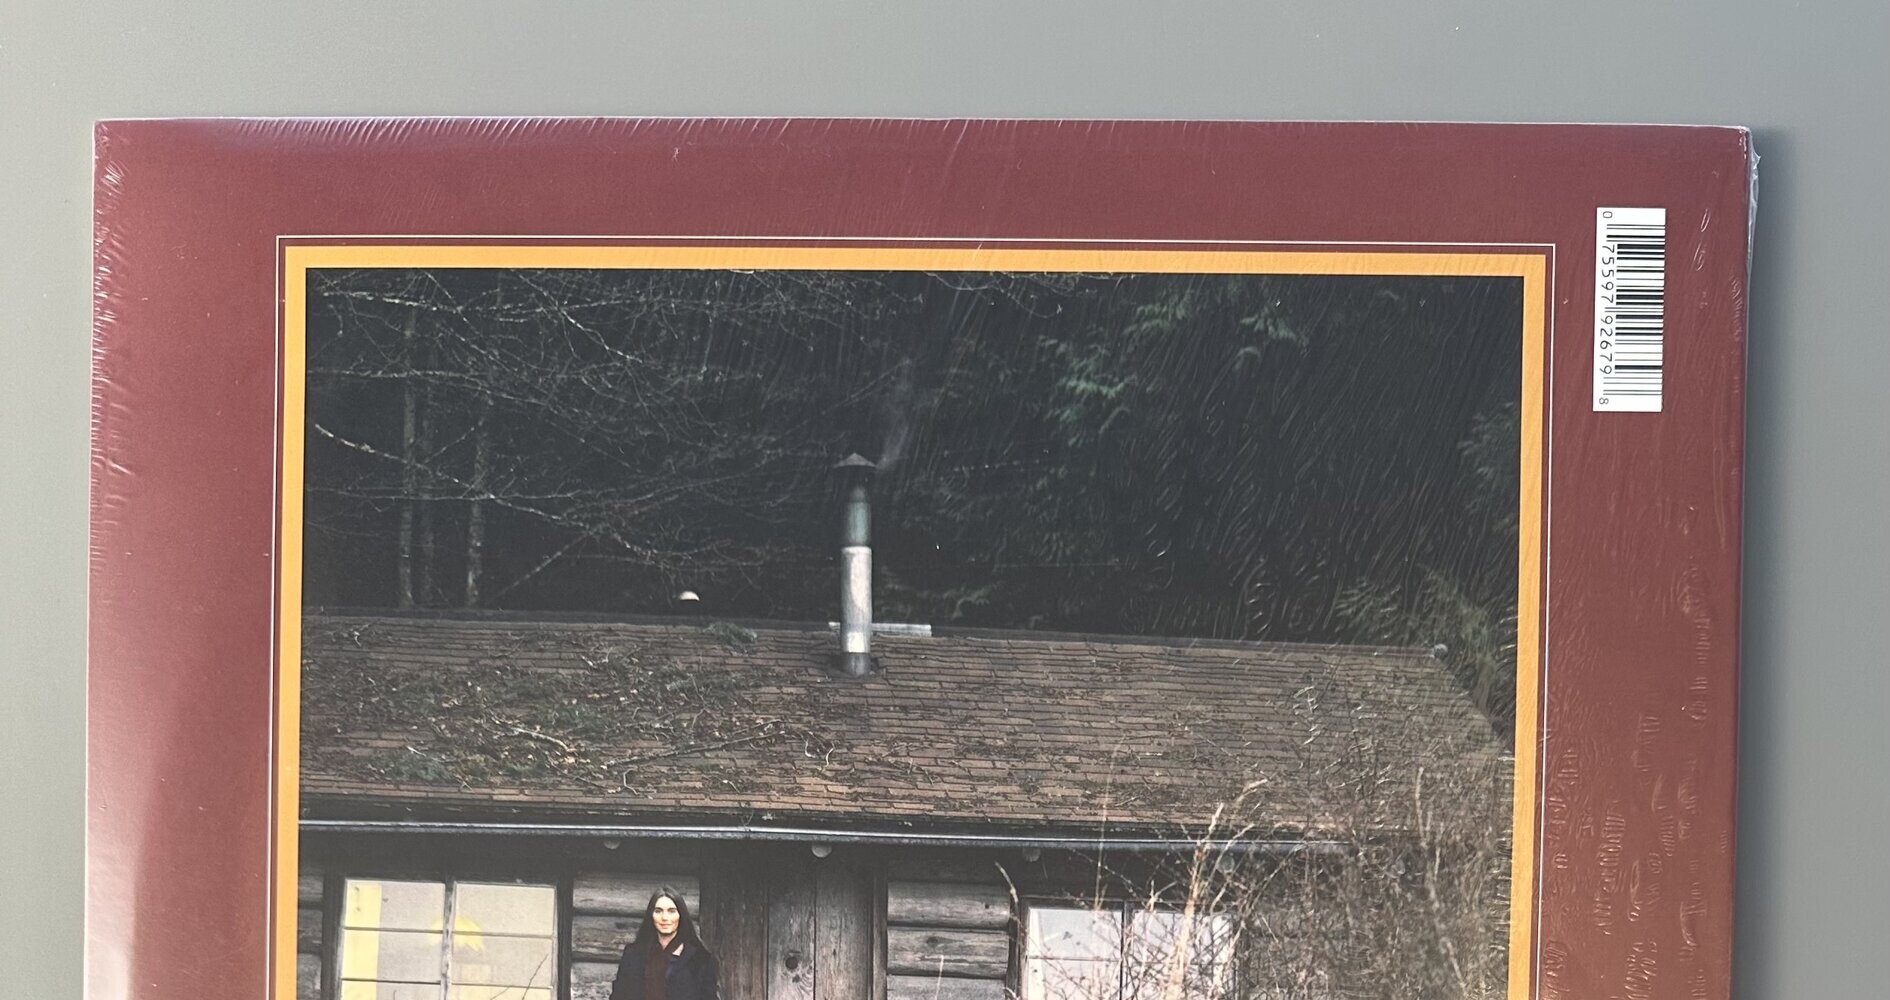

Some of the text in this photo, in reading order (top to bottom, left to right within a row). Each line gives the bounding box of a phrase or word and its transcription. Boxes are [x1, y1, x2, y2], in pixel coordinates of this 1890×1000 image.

[1603, 211, 1613, 219] 0
[1601, 244, 1615, 304] 75597
[1599, 315, 1614, 375] 92679
